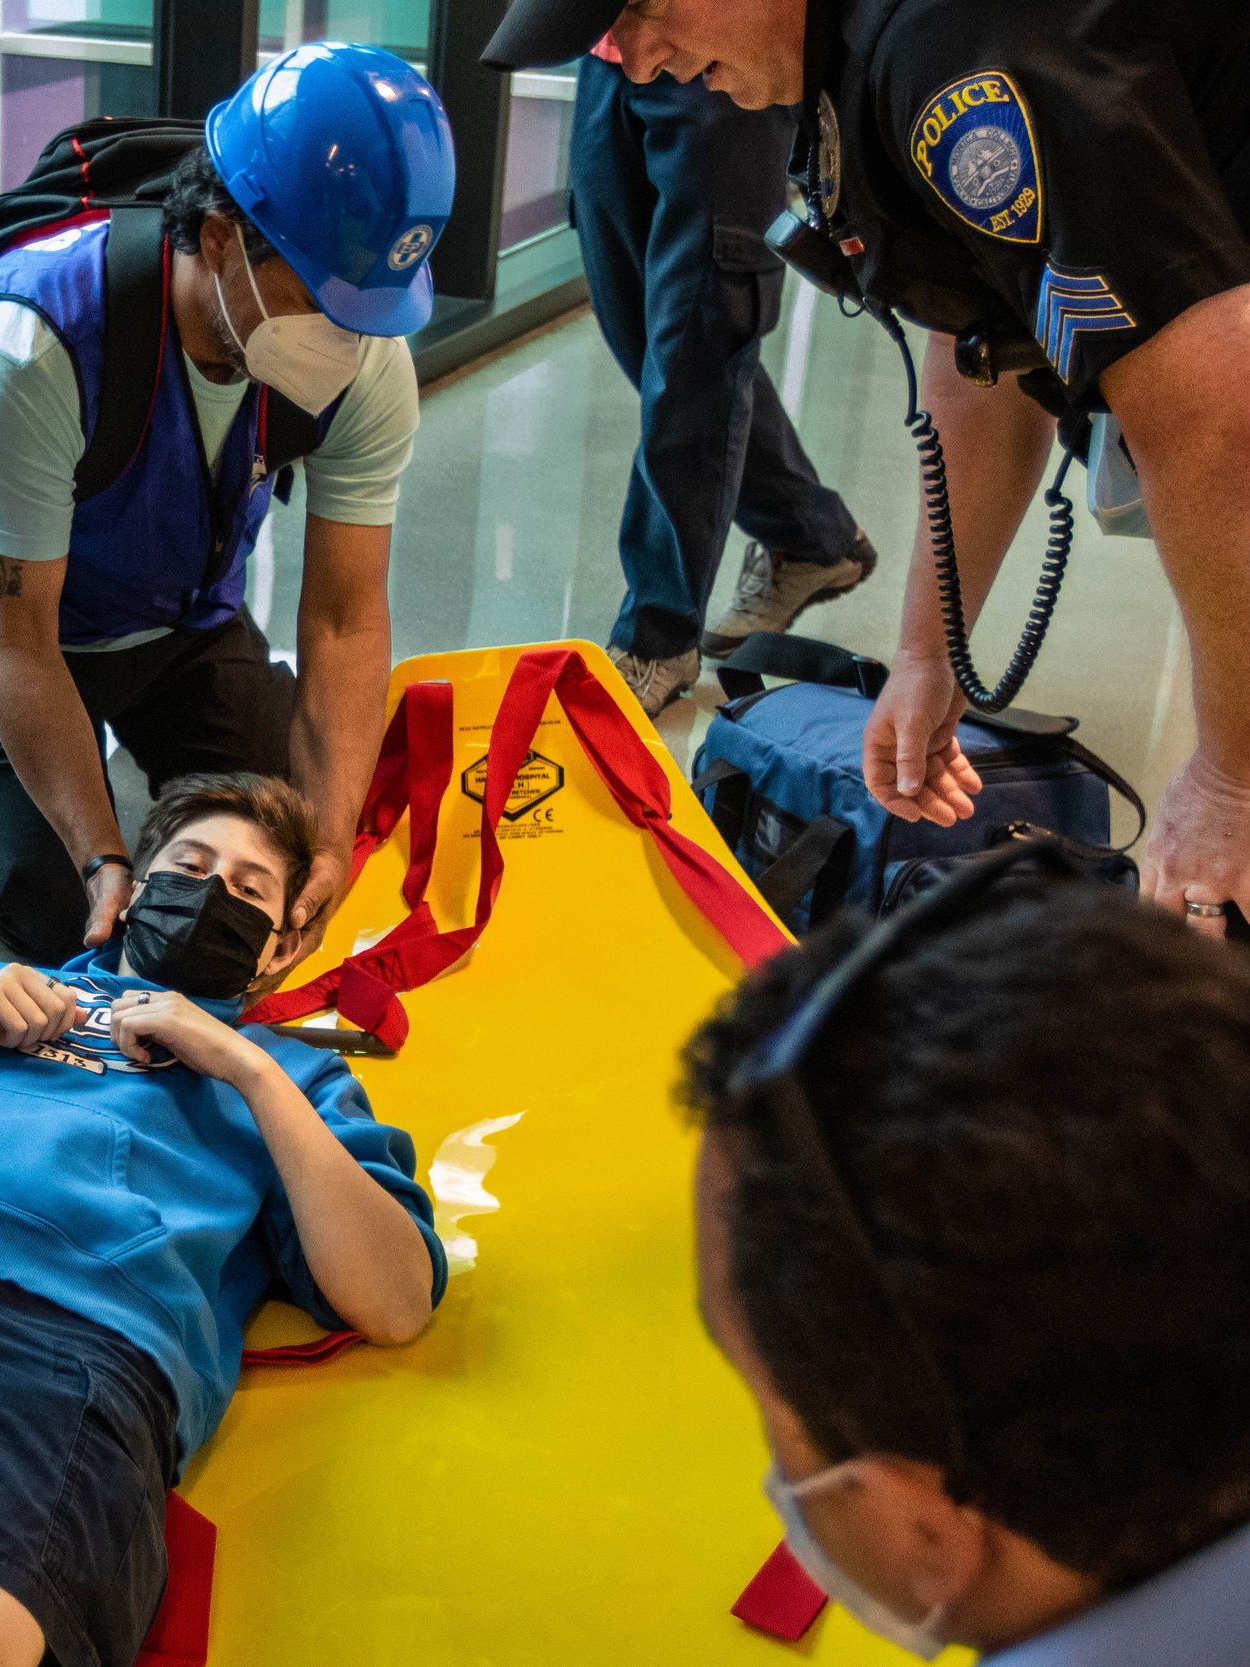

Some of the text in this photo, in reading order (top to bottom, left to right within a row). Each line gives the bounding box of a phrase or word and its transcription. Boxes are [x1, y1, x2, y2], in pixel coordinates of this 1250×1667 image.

[916, 80, 1010, 177] POLICE
[990, 186, 1037, 232] EST. 1929
[533, 808, 553, 823] CE
[31, 1044, 86, 1068] 1313
